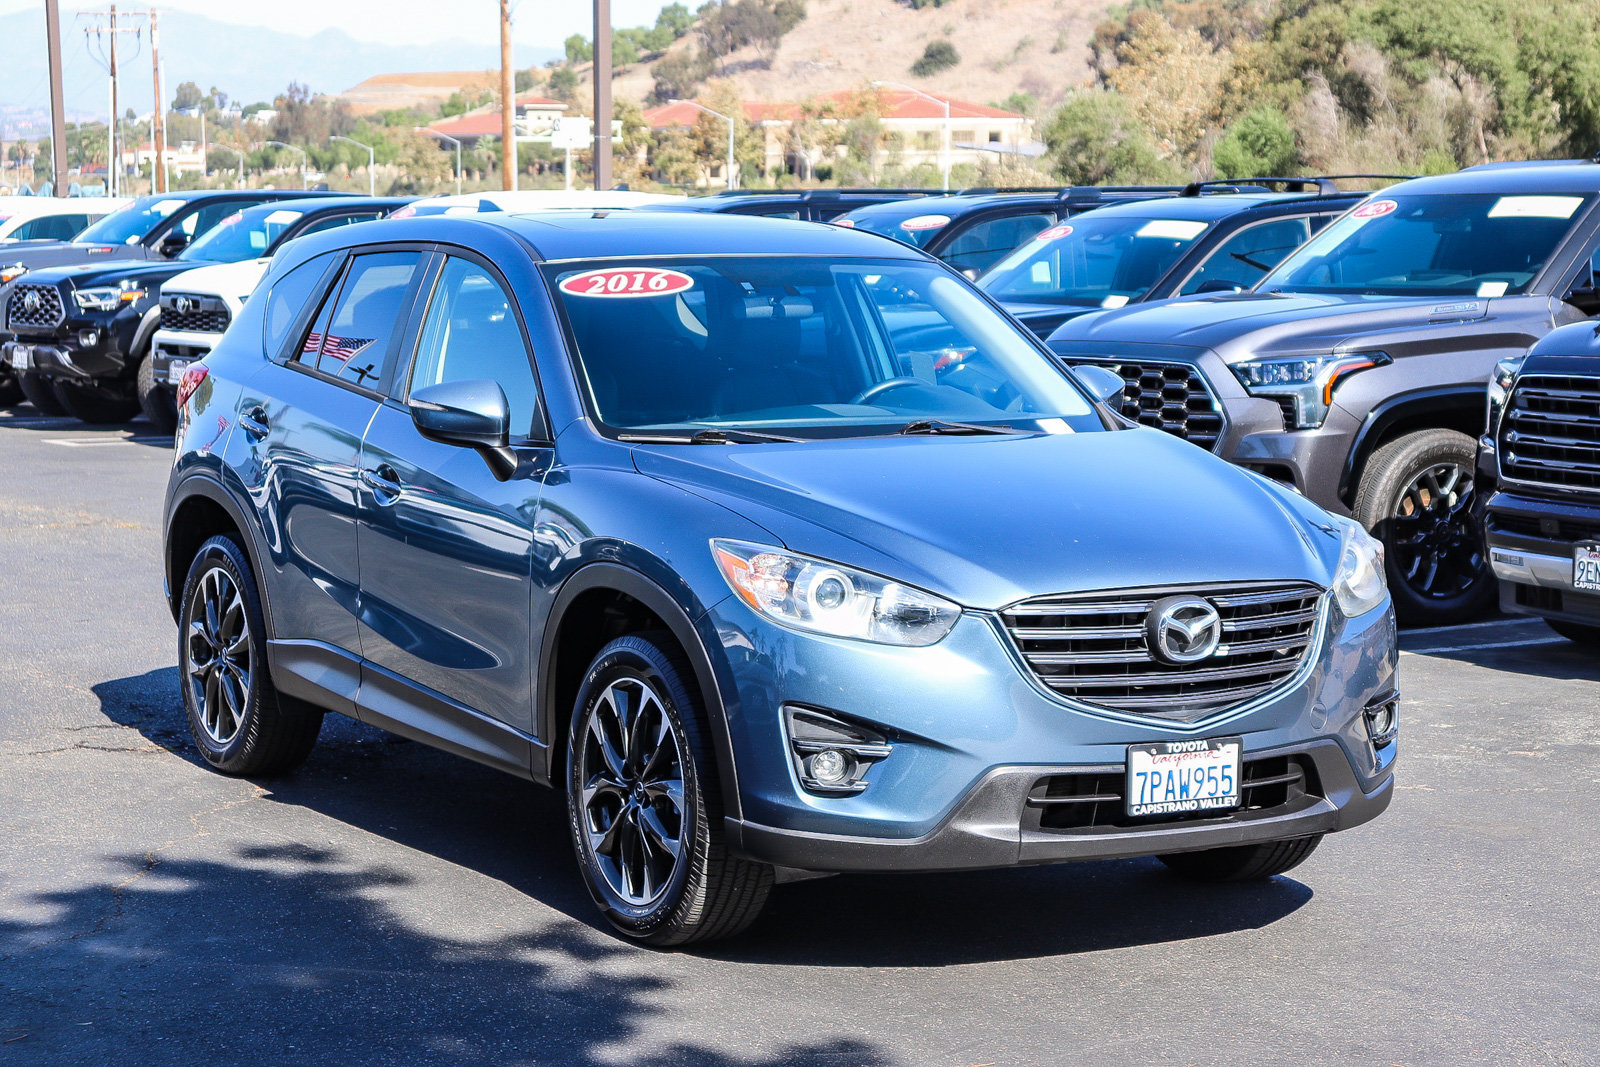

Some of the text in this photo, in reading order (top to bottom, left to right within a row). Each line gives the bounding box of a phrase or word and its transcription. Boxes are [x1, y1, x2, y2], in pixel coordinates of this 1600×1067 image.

[585, 273, 672, 294] 2016
[1166, 740, 1210, 753] TOYOTA
[1152, 750, 1220, 767] California
[1136, 764, 1232, 804] 7PAW955
[1132, 794, 1238, 816] CAPISTRANO VALLEY
